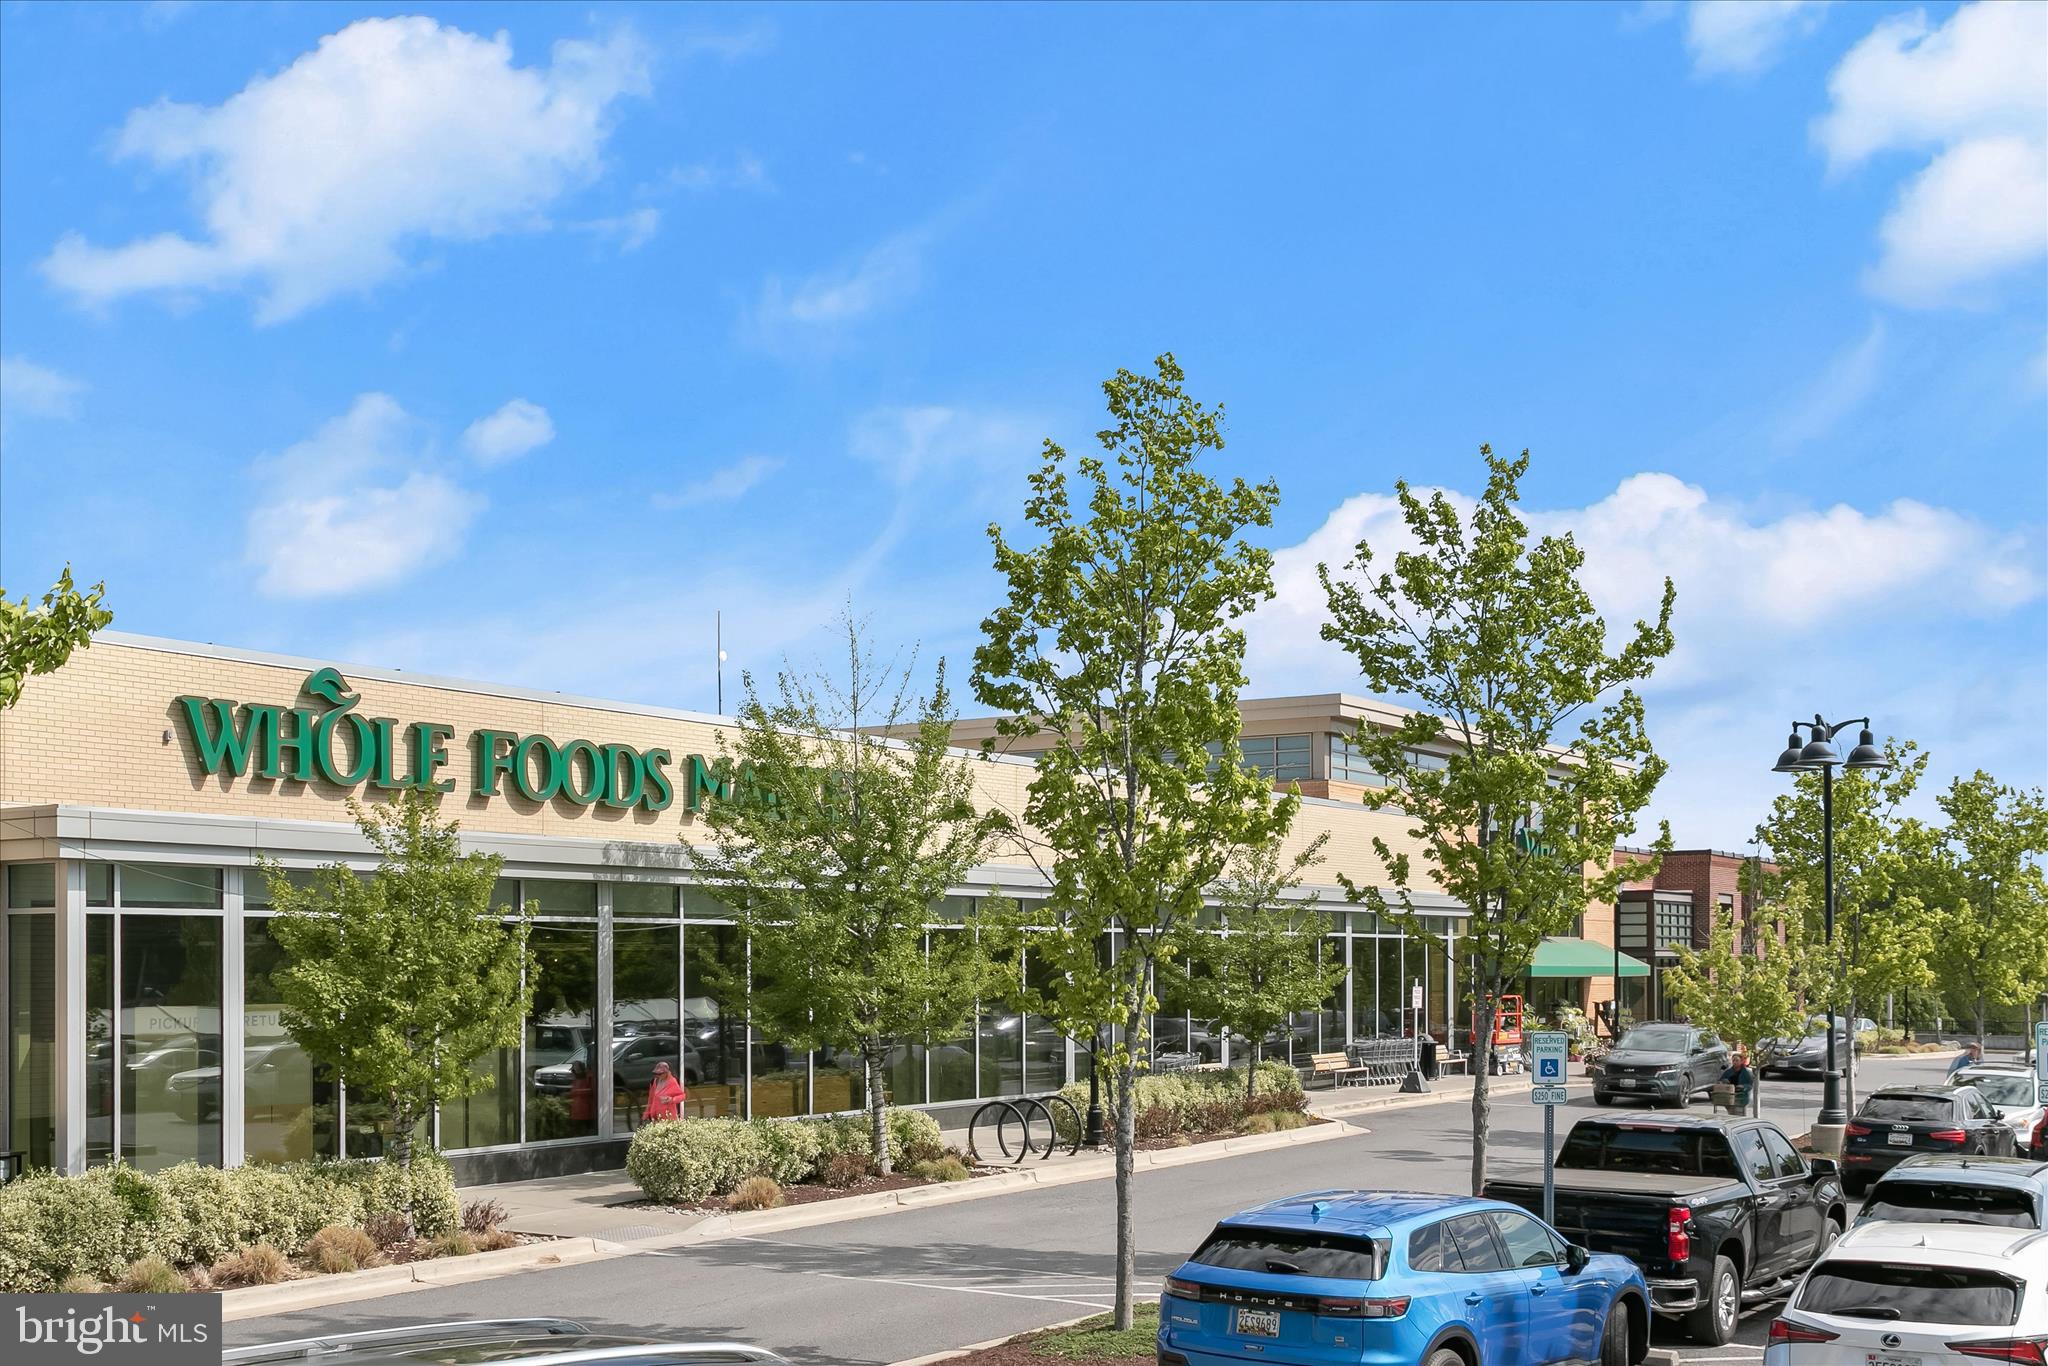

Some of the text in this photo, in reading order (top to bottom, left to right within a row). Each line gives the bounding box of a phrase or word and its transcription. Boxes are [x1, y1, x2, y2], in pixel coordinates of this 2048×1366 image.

[175, 667, 457, 793] WHOLE
[473, 728, 674, 812] FOODS
[150, 1016, 200, 1030] PICKUP
[244, 1014, 276, 1027] RETU
[1534, 1037, 1565, 1045] RESERVED
[1534, 1091, 1564, 1101] $250 FINE
